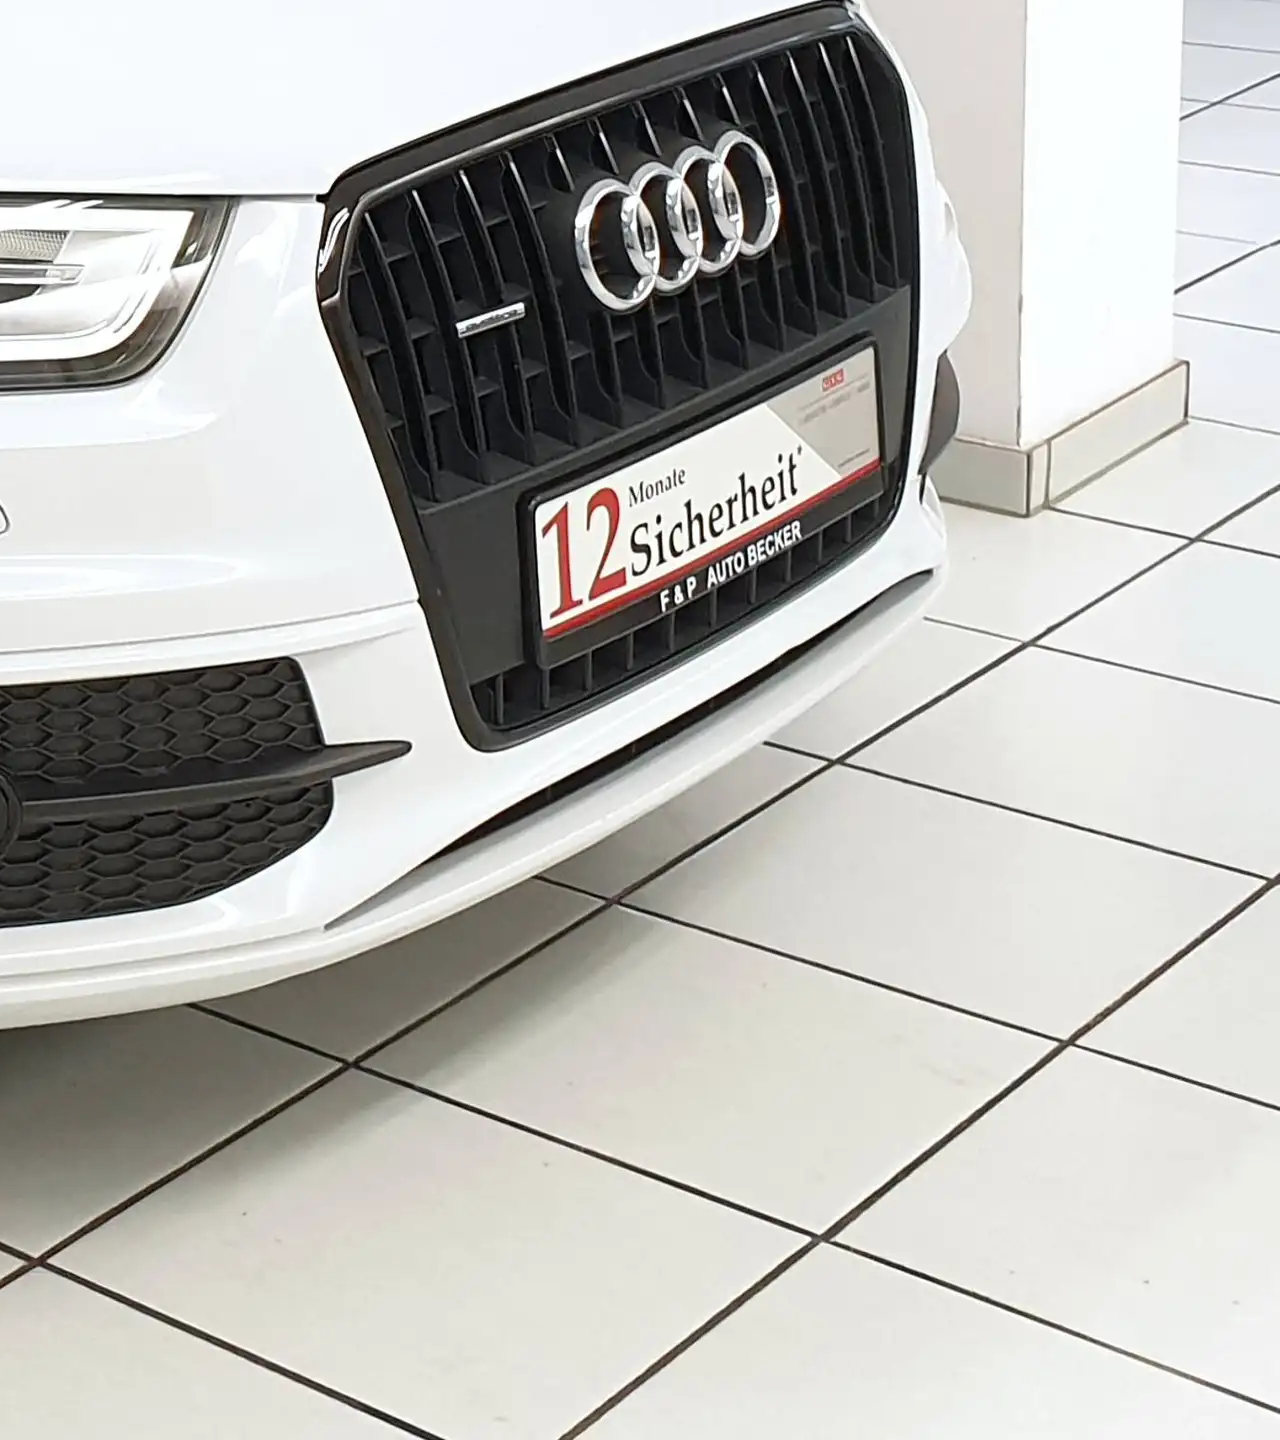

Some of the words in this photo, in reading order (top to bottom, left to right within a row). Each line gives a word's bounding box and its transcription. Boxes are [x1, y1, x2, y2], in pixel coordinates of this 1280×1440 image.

[542, 486, 628, 619] 12
[628, 467, 686, 508] Monate
[707, 551, 745, 589] AUTO
[746, 520, 802, 567] BECKER
